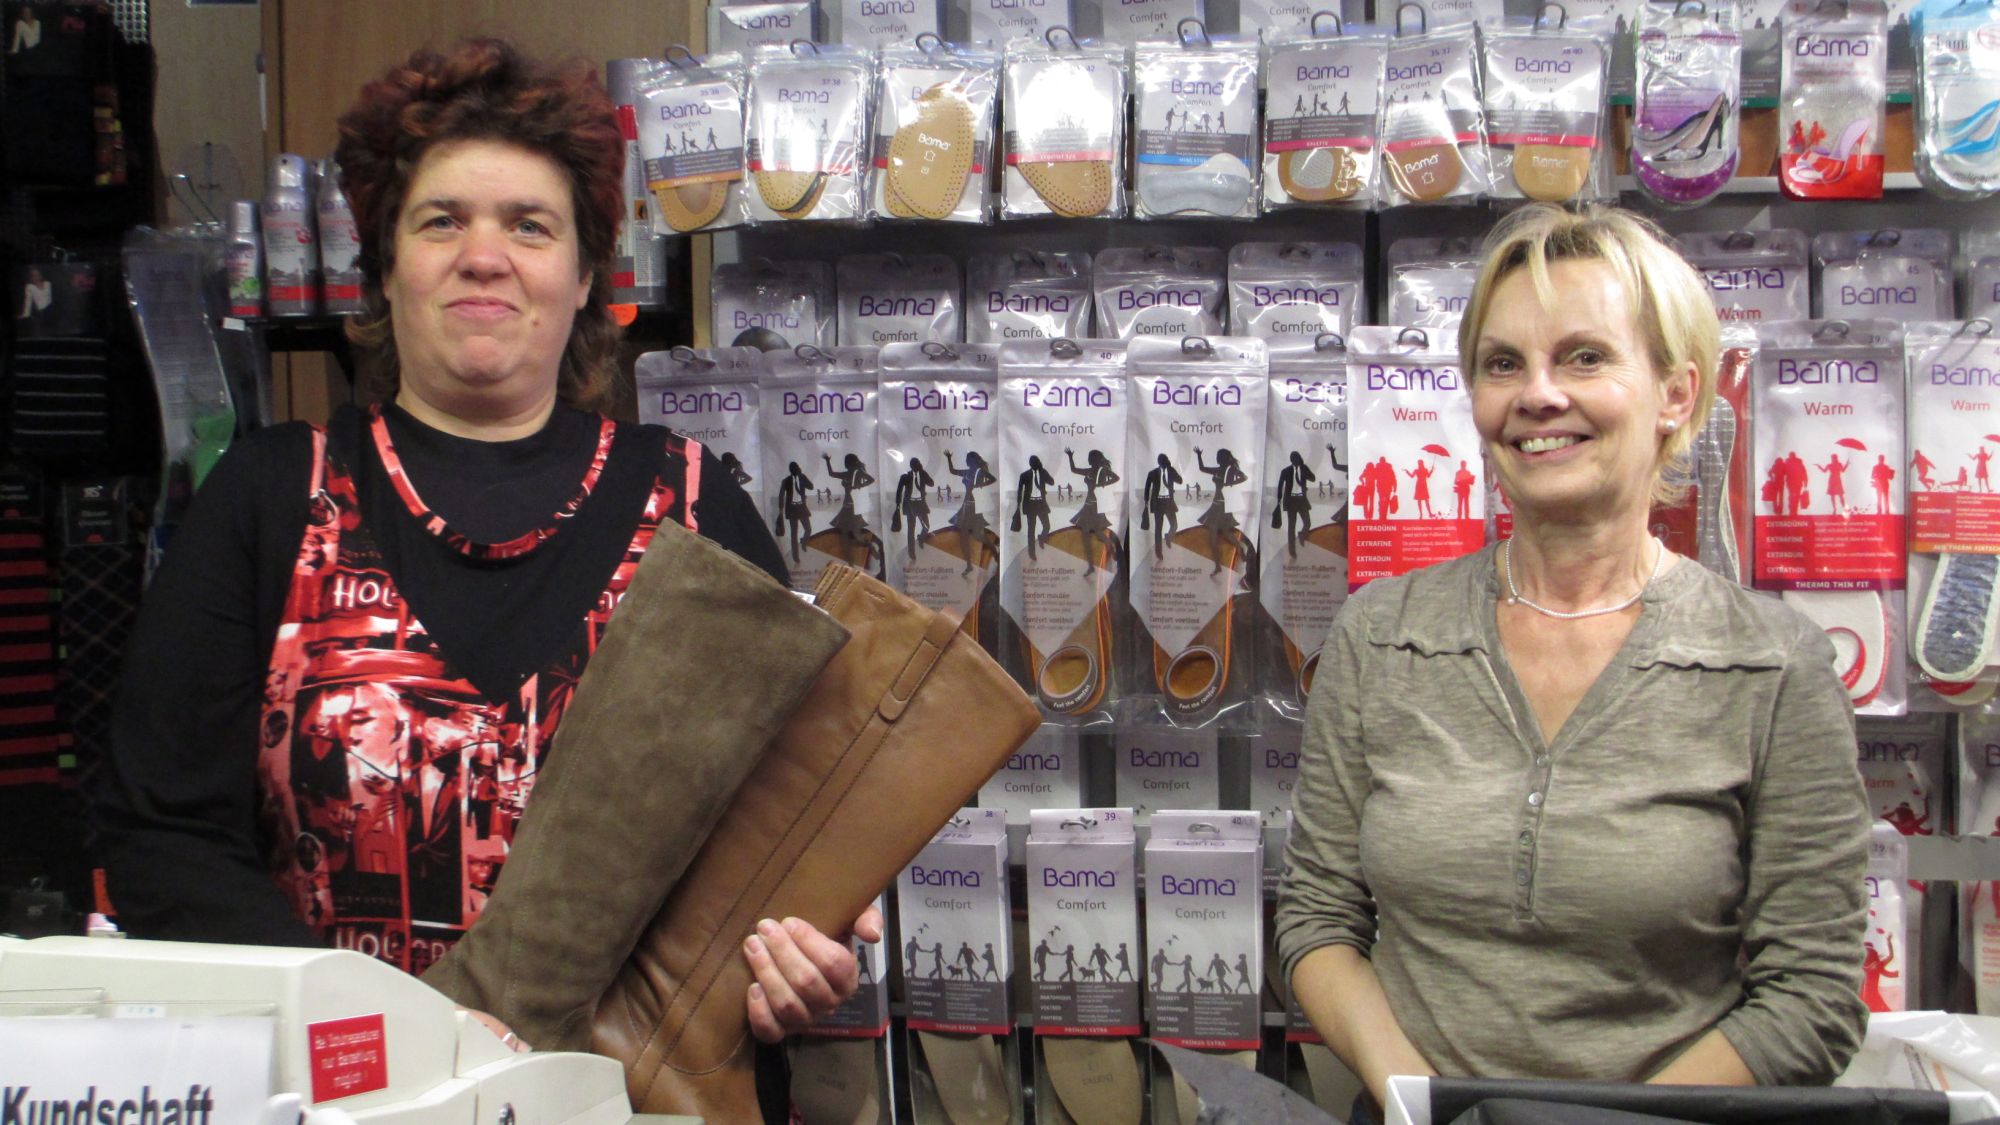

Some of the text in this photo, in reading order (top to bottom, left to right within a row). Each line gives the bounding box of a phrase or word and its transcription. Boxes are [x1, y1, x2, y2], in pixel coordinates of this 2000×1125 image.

[861, 0, 914, 16] Bama
[1269, 5, 1310, 17] Comfort
[999, 17, 1038, 27] Comfort
[1129, 12, 1167, 24] Comfort
[869, 24, 909, 34] Comfort
[1297, 65, 1350, 81] Bama
[1387, 61, 1443, 81] Bama
[1515, 57, 1572, 74] Bama
[1171, 78, 1225, 96] Bama
[1307, 81, 1336, 91] Comfort
[1400, 80, 1431, 91] Comfort
[779, 88, 830, 104] Bama
[660, 103, 712, 120] Bama
[673, 120, 702, 131] Comfort
[918, 132, 950, 150] Bama
[1404, 153, 1440, 173] Bama
[1704, 268, 1784, 291] ama
[988, 291, 1070, 313] Bama
[1118, 288, 1202, 310] Bama
[1254, 286, 1340, 306] Bama
[1841, 286, 1917, 305] Bama
[858, 296, 936, 317] Bama
[1716, 307, 1762, 320] Warm
[734, 310, 799, 329] Bama
[1271, 320, 1324, 334] Comfort
[1003, 327, 1049, 341] Comfo
[1135, 322, 1186, 335] Comfort
[872, 330, 919, 344] Comfort
[1367, 364, 1458, 391] Bama
[1779, 359, 1879, 384] Bama
[904, 386, 989, 411] Bama
[1023, 383, 1112, 407] Bama
[1153, 380, 1241, 406] Bama
[662, 391, 742, 415] Bama
[783, 392, 864, 415] Bama
[1804, 402, 1854, 415] Warm
[1950, 400, 1991, 412] Warm
[1392, 408, 1438, 422] Warm
[921, 425, 972, 439] Comfort
[1041, 422, 1095, 436] Comfort
[1170, 421, 1223, 436] Comfort
[1303, 418, 1347, 432] Comfo
[799, 428, 850, 442] Comfort
[1131, 748, 1200, 769] Bama
[1266, 749, 1298, 769] Ba
[1858, 740, 1919, 762] ama
[1004, 781, 1052, 795] Comfort
[1143, 779, 1191, 792] Comfort
[1864, 778, 1895, 789] arm
[912, 866, 981, 888] Bama
[1043, 868, 1116, 888] Bama
[1162, 875, 1236, 897] Bama
[924, 897, 973, 911] Comfort
[1057, 899, 1107, 912] Comfort
[1175, 908, 1226, 921] Comfort
[2, 1084, 214, 1125] Kundschaft
